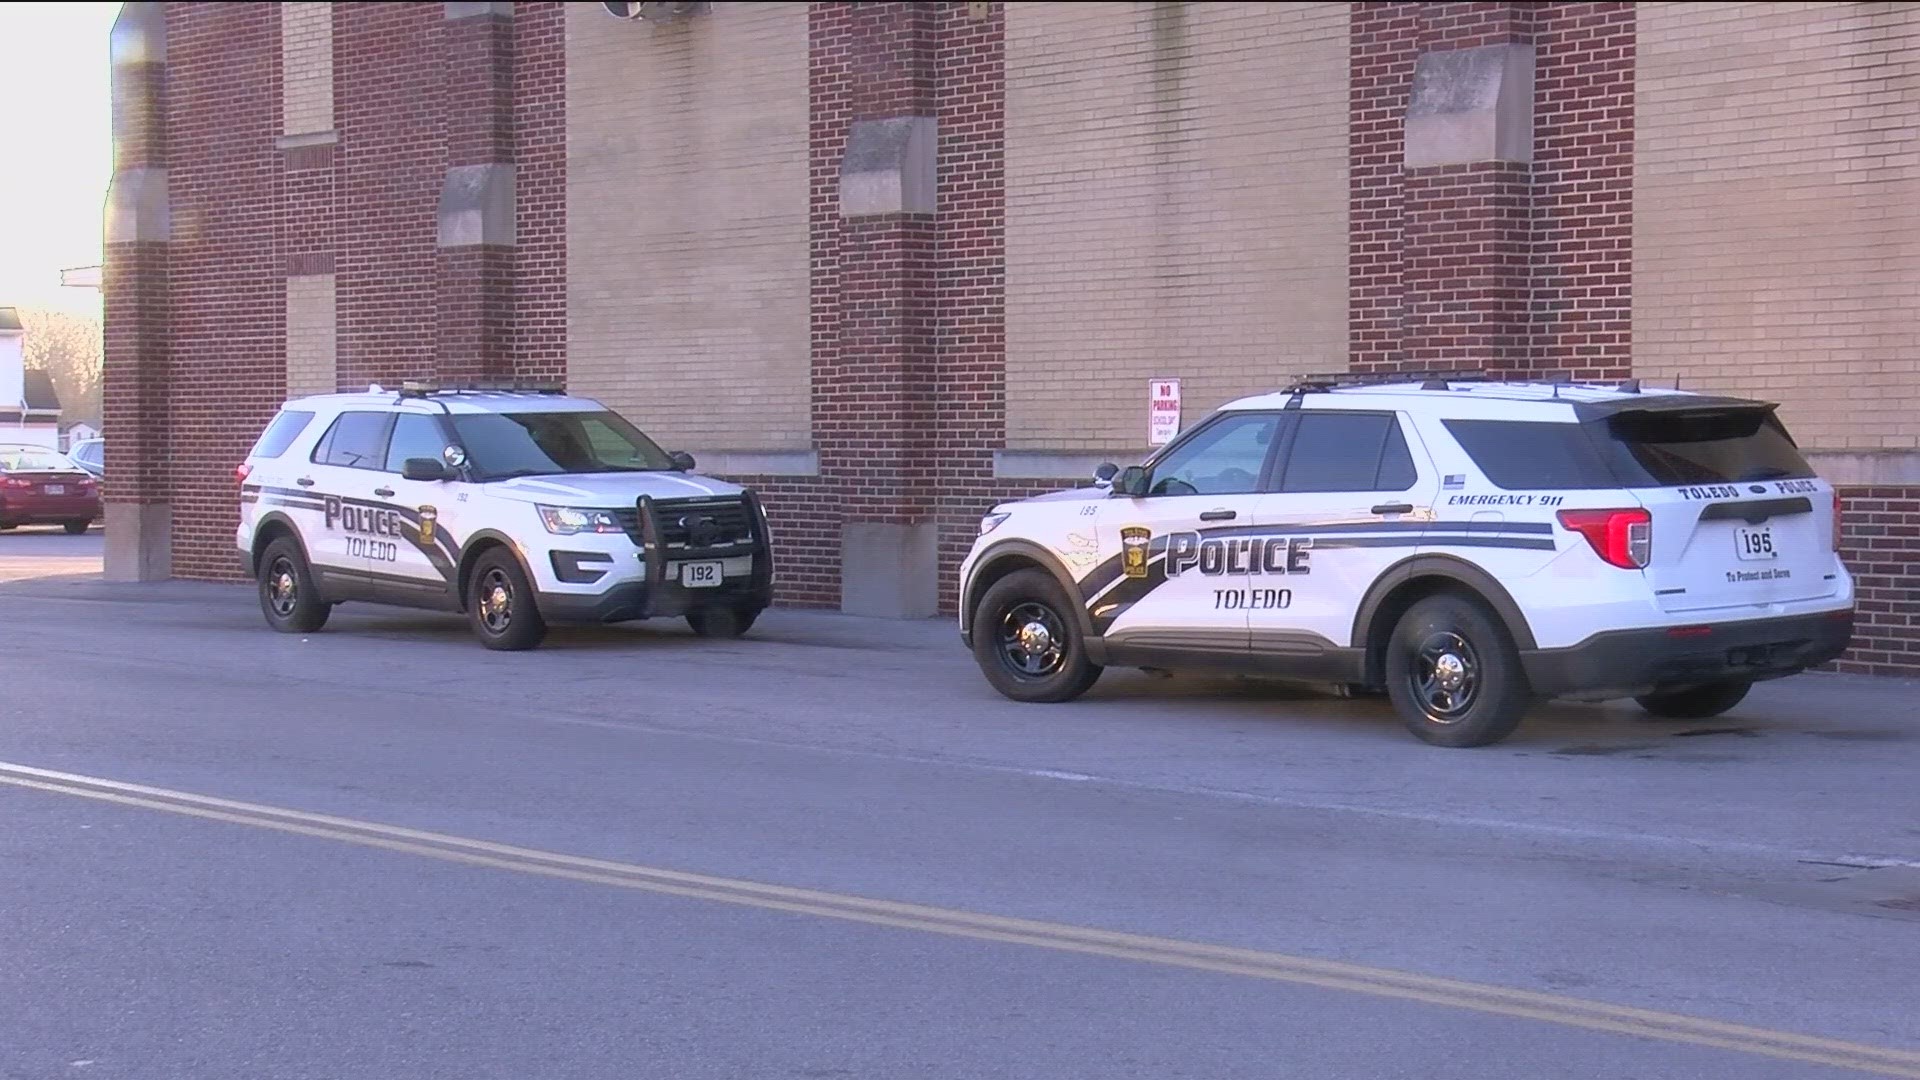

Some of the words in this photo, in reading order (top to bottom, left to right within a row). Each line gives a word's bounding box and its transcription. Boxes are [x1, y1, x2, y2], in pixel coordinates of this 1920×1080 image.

[1160, 385, 1171, 397] NO
[1153, 399, 1177, 411] PARKING
[1677, 485, 1740, 500] TOLEDO
[1775, 480, 1818, 494] POLICE
[1448, 495, 1537, 506] EMERGENCY
[1538, 495, 1564, 506] 911
[324, 495, 402, 538] POLICE
[345, 535, 397, 562] TOLEDO
[1744, 532, 1773, 553] 195
[1165, 530, 1313, 578] POLICE
[691, 565, 714, 581] 192
[1726, 571, 1736, 583] To
[1737, 570, 1760, 582] Protect
[1761, 569, 1773, 581] and
[1773, 568, 1791, 580] Serve
[1213, 588, 1292, 609] TOLEDO
